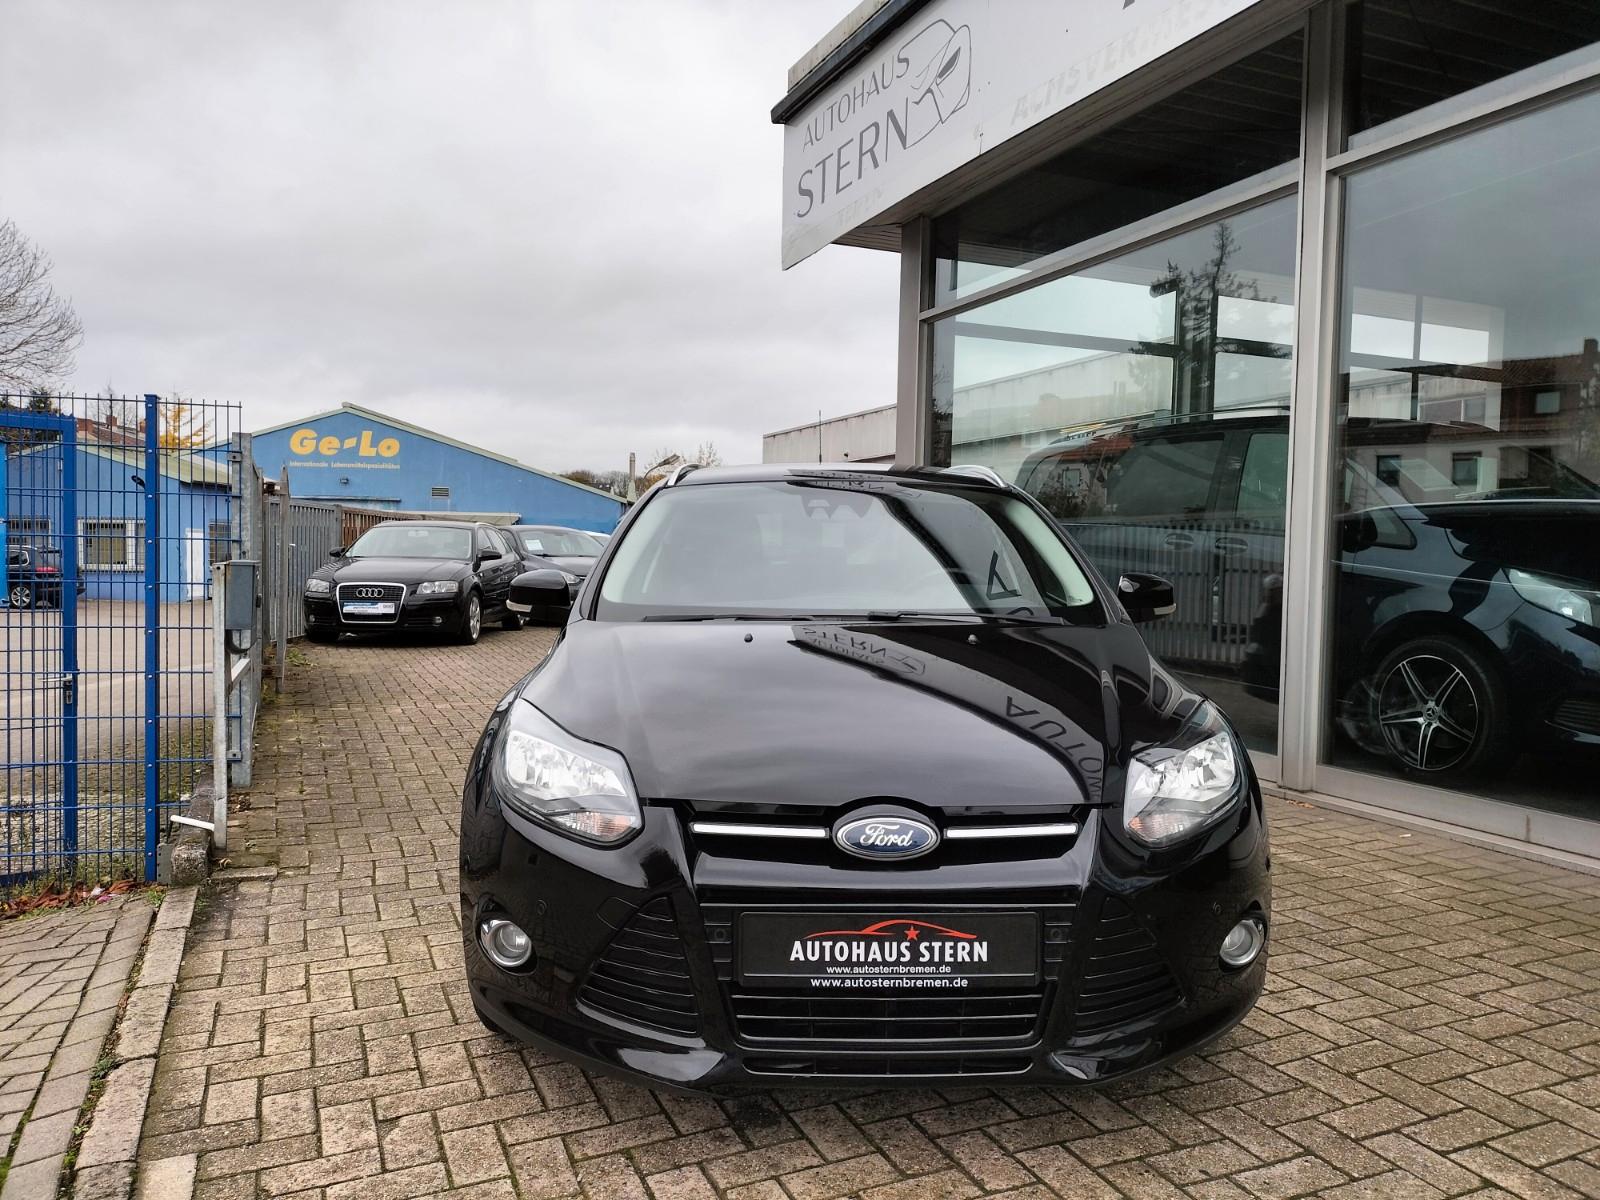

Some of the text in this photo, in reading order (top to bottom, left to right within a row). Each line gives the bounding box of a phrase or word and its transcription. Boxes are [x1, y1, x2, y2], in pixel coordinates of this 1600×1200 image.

[802, 43, 911, 152] AUTOHAUS
[797, 96, 908, 218] STERN
[290, 429, 400, 457] Ge-Lo
[860, 823, 914, 846] Ford
[789, 940, 988, 962] AUTOHAUS STERN
[826, 964, 951, 974] www.autosternbremen.de
[811, 976, 968, 988] www.autosternbremen.de
